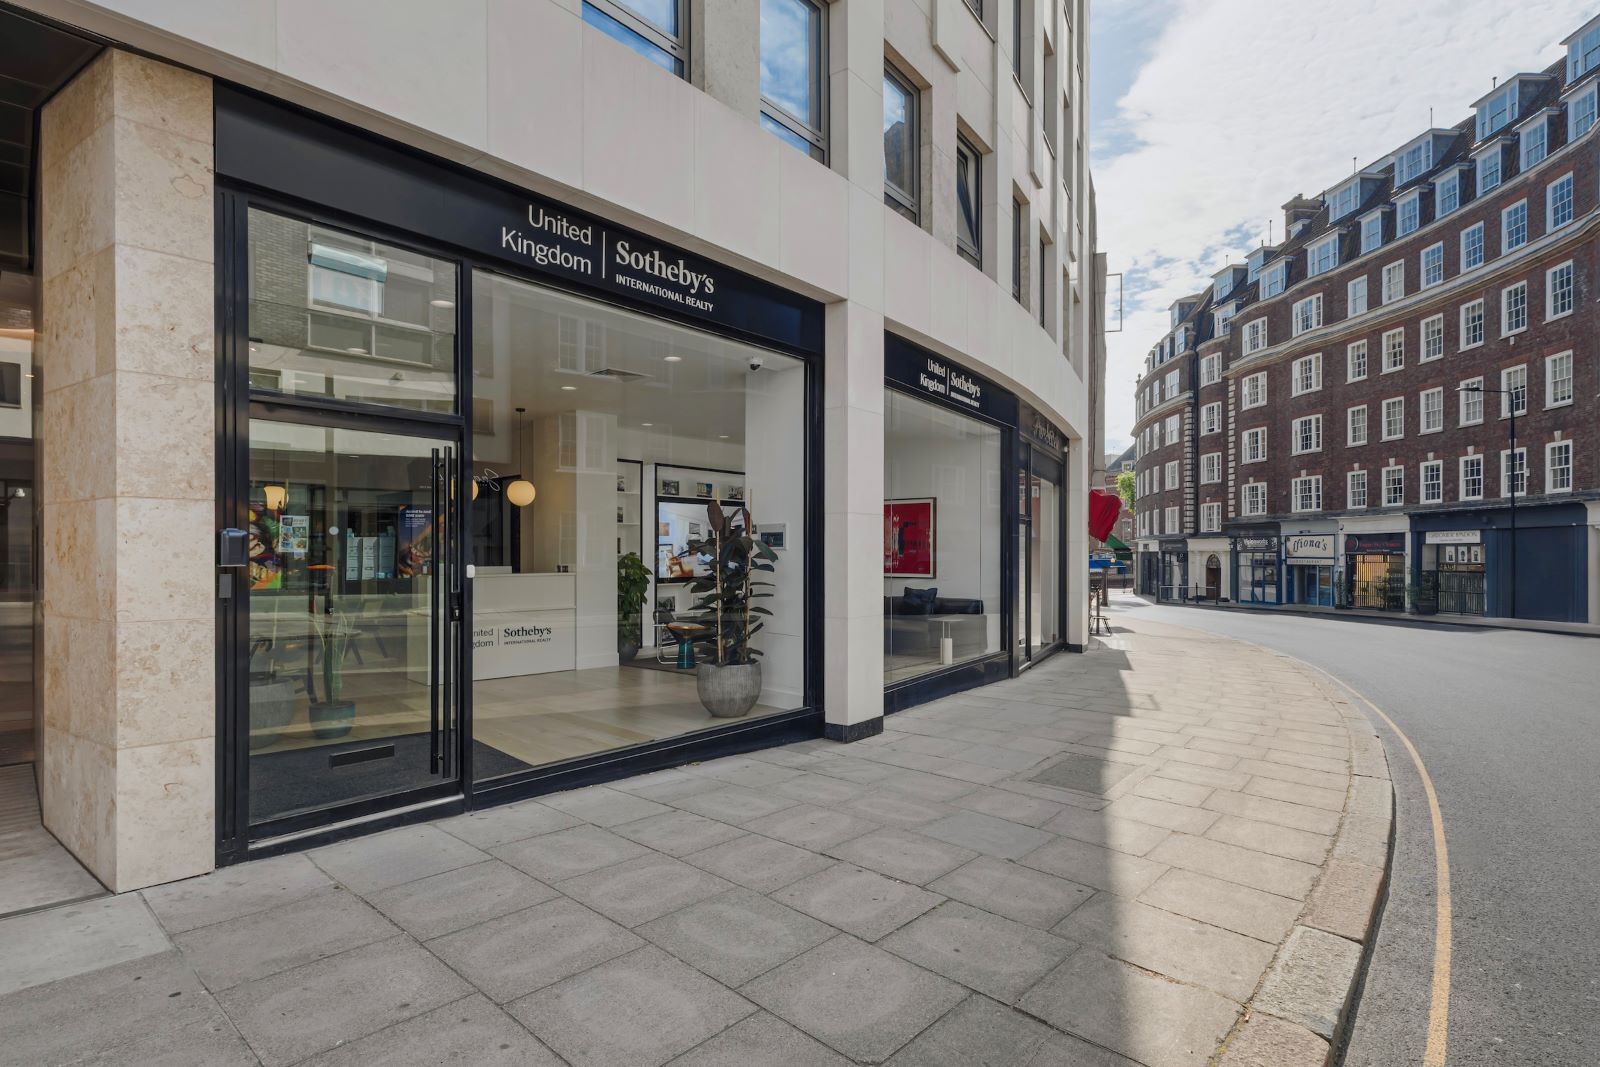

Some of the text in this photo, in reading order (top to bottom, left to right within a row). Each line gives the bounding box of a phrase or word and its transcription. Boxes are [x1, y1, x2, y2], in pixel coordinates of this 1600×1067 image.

[528, 204, 592, 245] United
[501, 226, 592, 274] Kingdom
[615, 240, 715, 294] Sotheby's
[615, 273, 714, 312] INTERNATIONAL REALTY
[927, 358, 946, 377] United
[920, 372, 946, 394] Kingdom
[950, 372, 981, 398] Sotheby's
[473, 628, 494, 637] nited
[503, 625, 552, 638] Sotheby's
